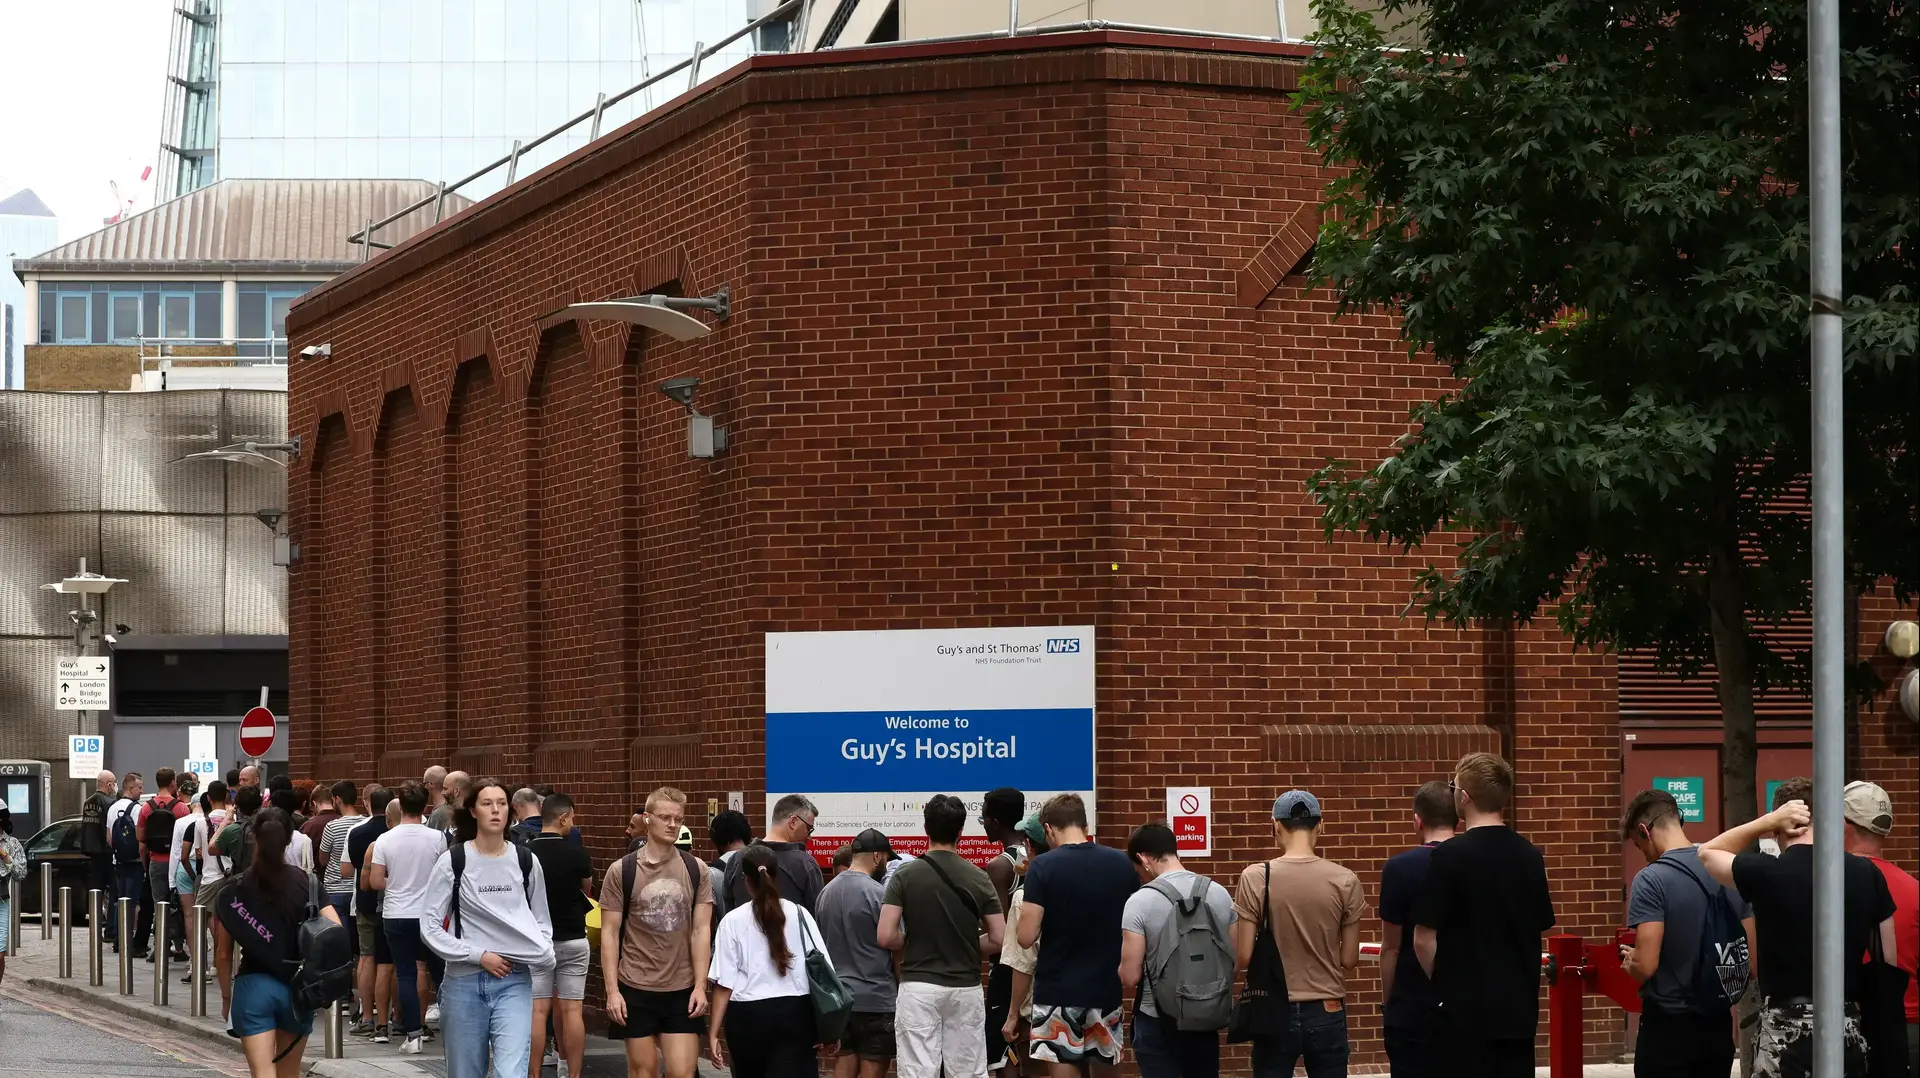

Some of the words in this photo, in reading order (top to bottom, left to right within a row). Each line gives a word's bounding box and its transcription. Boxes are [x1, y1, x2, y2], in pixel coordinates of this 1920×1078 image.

[937, 645, 963, 656] Guy's
[966, 644, 984, 654] and
[987, 644, 997, 653] St
[1000, 643, 1041, 653] Thomas'
[1047, 639, 1079, 653] NHS
[60, 661, 79, 669] Guy's
[79, 690, 102, 698] Bridge
[885, 716, 950, 729] Welcome
[954, 717, 970, 729] to
[841, 738, 907, 766] Guy's
[915, 735, 1016, 764] Hospital
[1667, 781, 1689, 791] FIRE
[1672, 793, 1697, 803] CAPE
[889, 838, 928, 847] Emergency
[1176, 834, 1204, 843] parking
[976, 847, 1000, 855] Palace
[230, 896, 274, 943] YEHLEX
